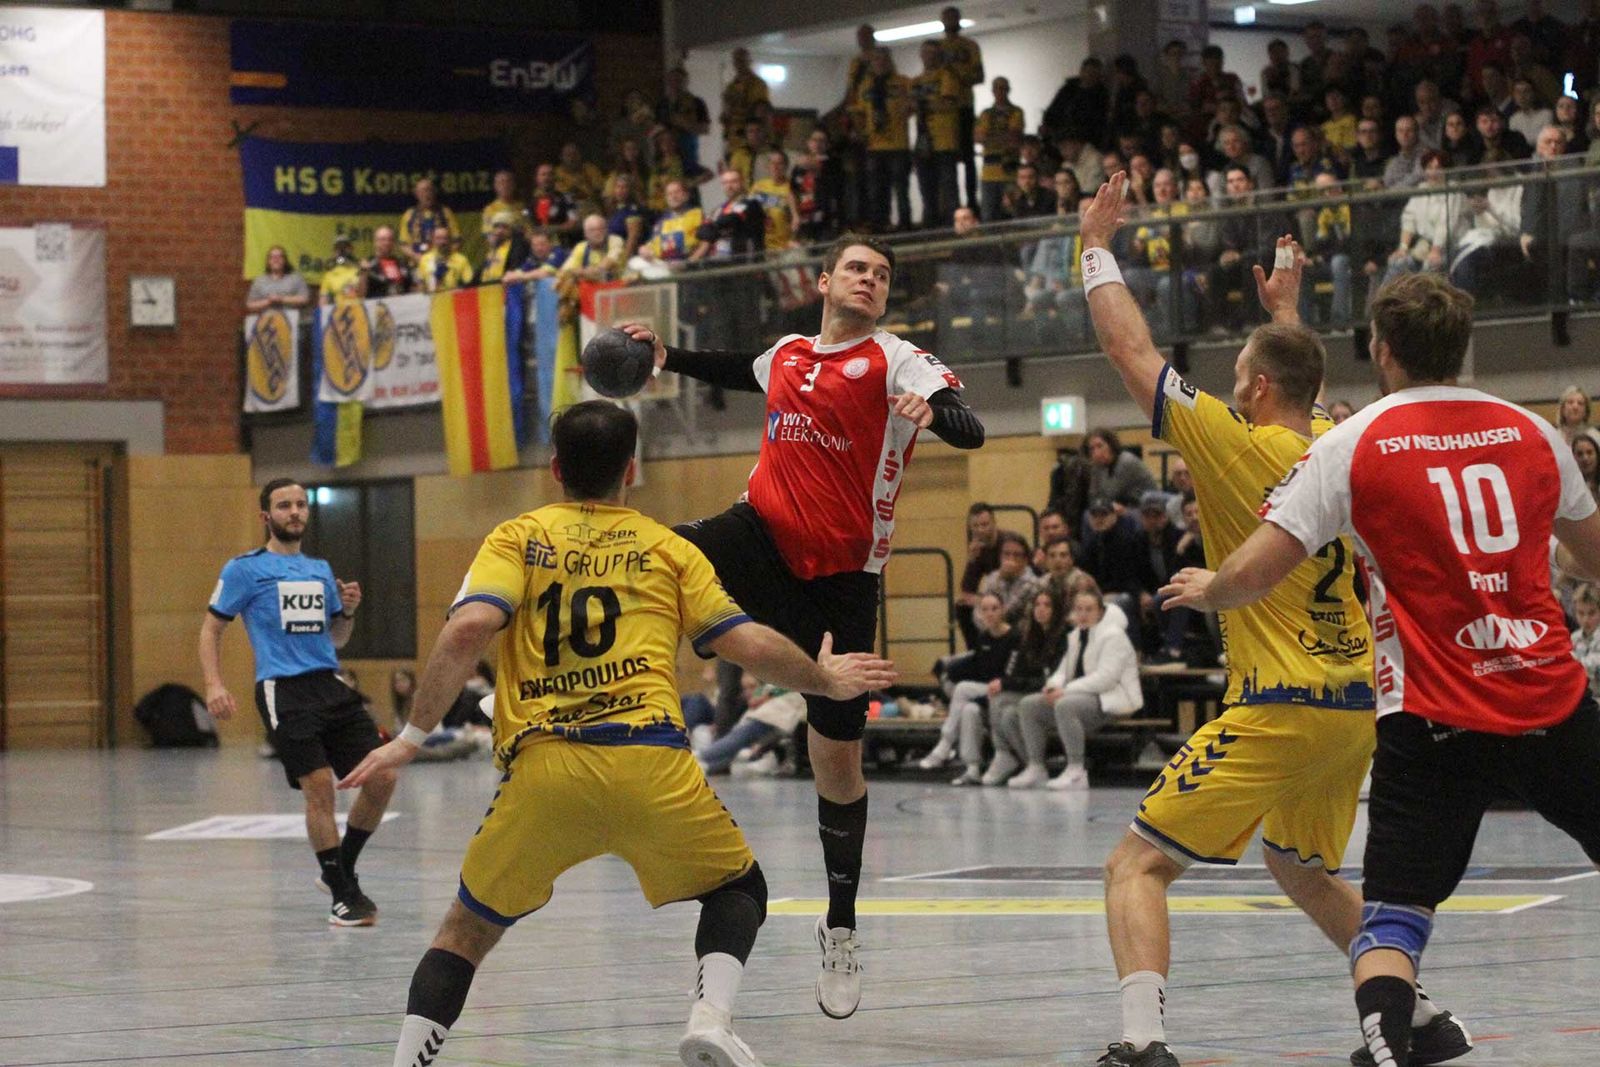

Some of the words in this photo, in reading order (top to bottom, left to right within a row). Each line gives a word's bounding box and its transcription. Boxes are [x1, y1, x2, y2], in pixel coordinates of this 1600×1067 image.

[490, 58, 579, 90] EnBW
[274, 166, 344, 195] HSG
[353, 168, 491, 194] Konstanz
[800, 362, 822, 392] 3
[781, 427, 853, 452] ELEKRONIK
[1376, 436, 1410, 455] TSV
[1413, 426, 1522, 451] NEUHAUSEN
[1427, 463, 1520, 555] 10
[564, 550, 653, 577] GRUPPE
[1314, 536, 1346, 603] 2
[1468, 570, 1508, 593] RTH
[536, 581, 622, 668] 10
